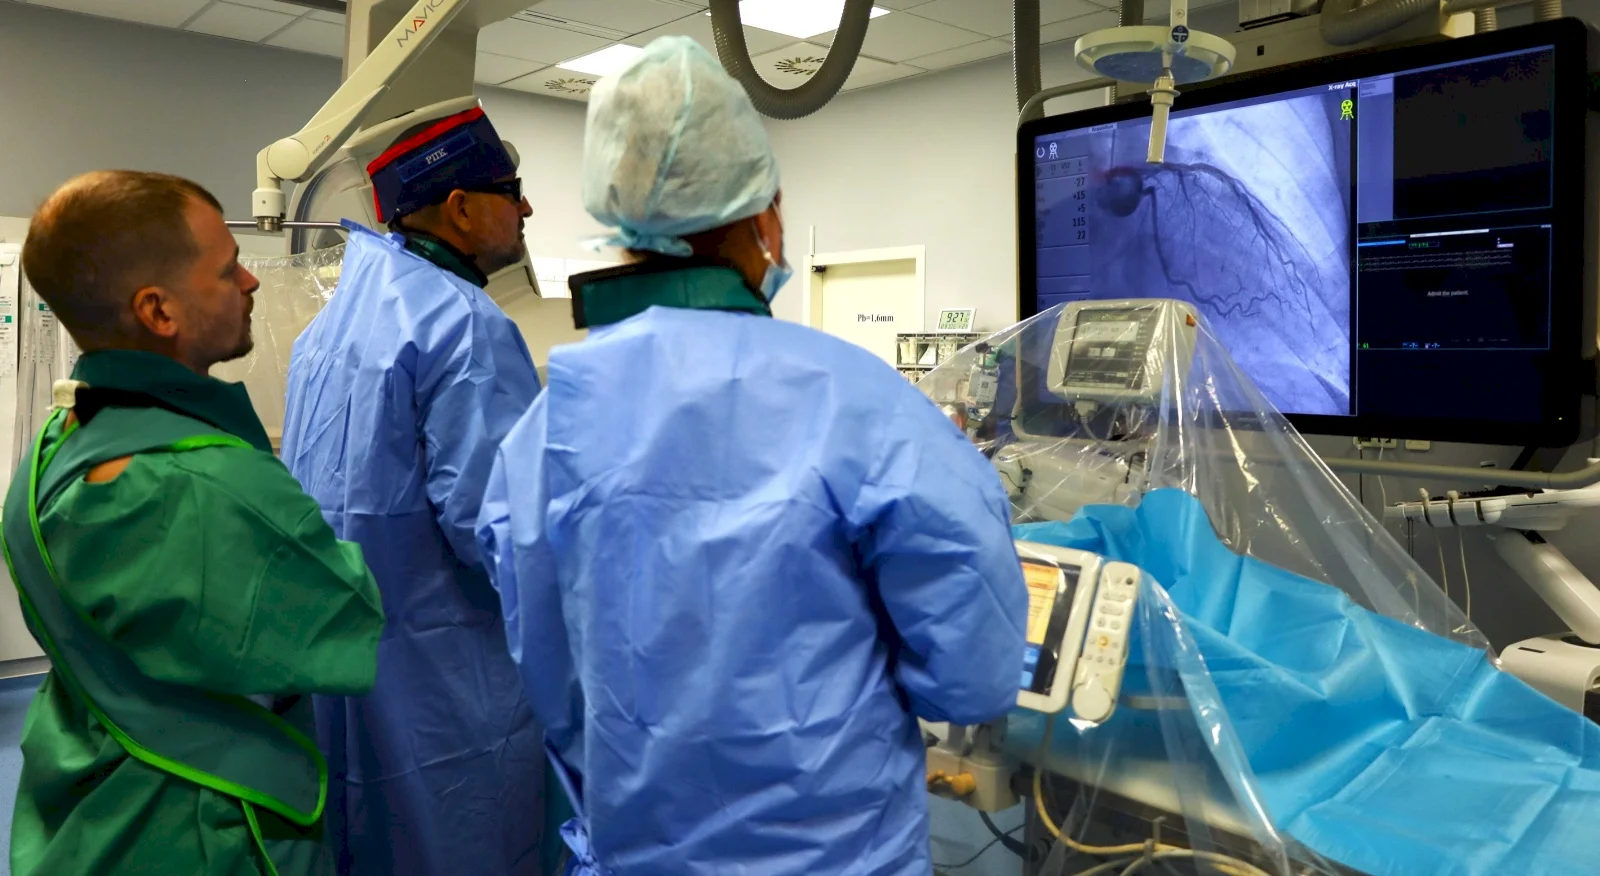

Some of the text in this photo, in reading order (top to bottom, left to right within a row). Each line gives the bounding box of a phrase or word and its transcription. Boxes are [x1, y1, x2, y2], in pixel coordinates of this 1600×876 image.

[1072, 217, 1086, 227] 115
[1076, 230, 1086, 240] 22
[857, 313, 894, 323] Pb=1,6mm
